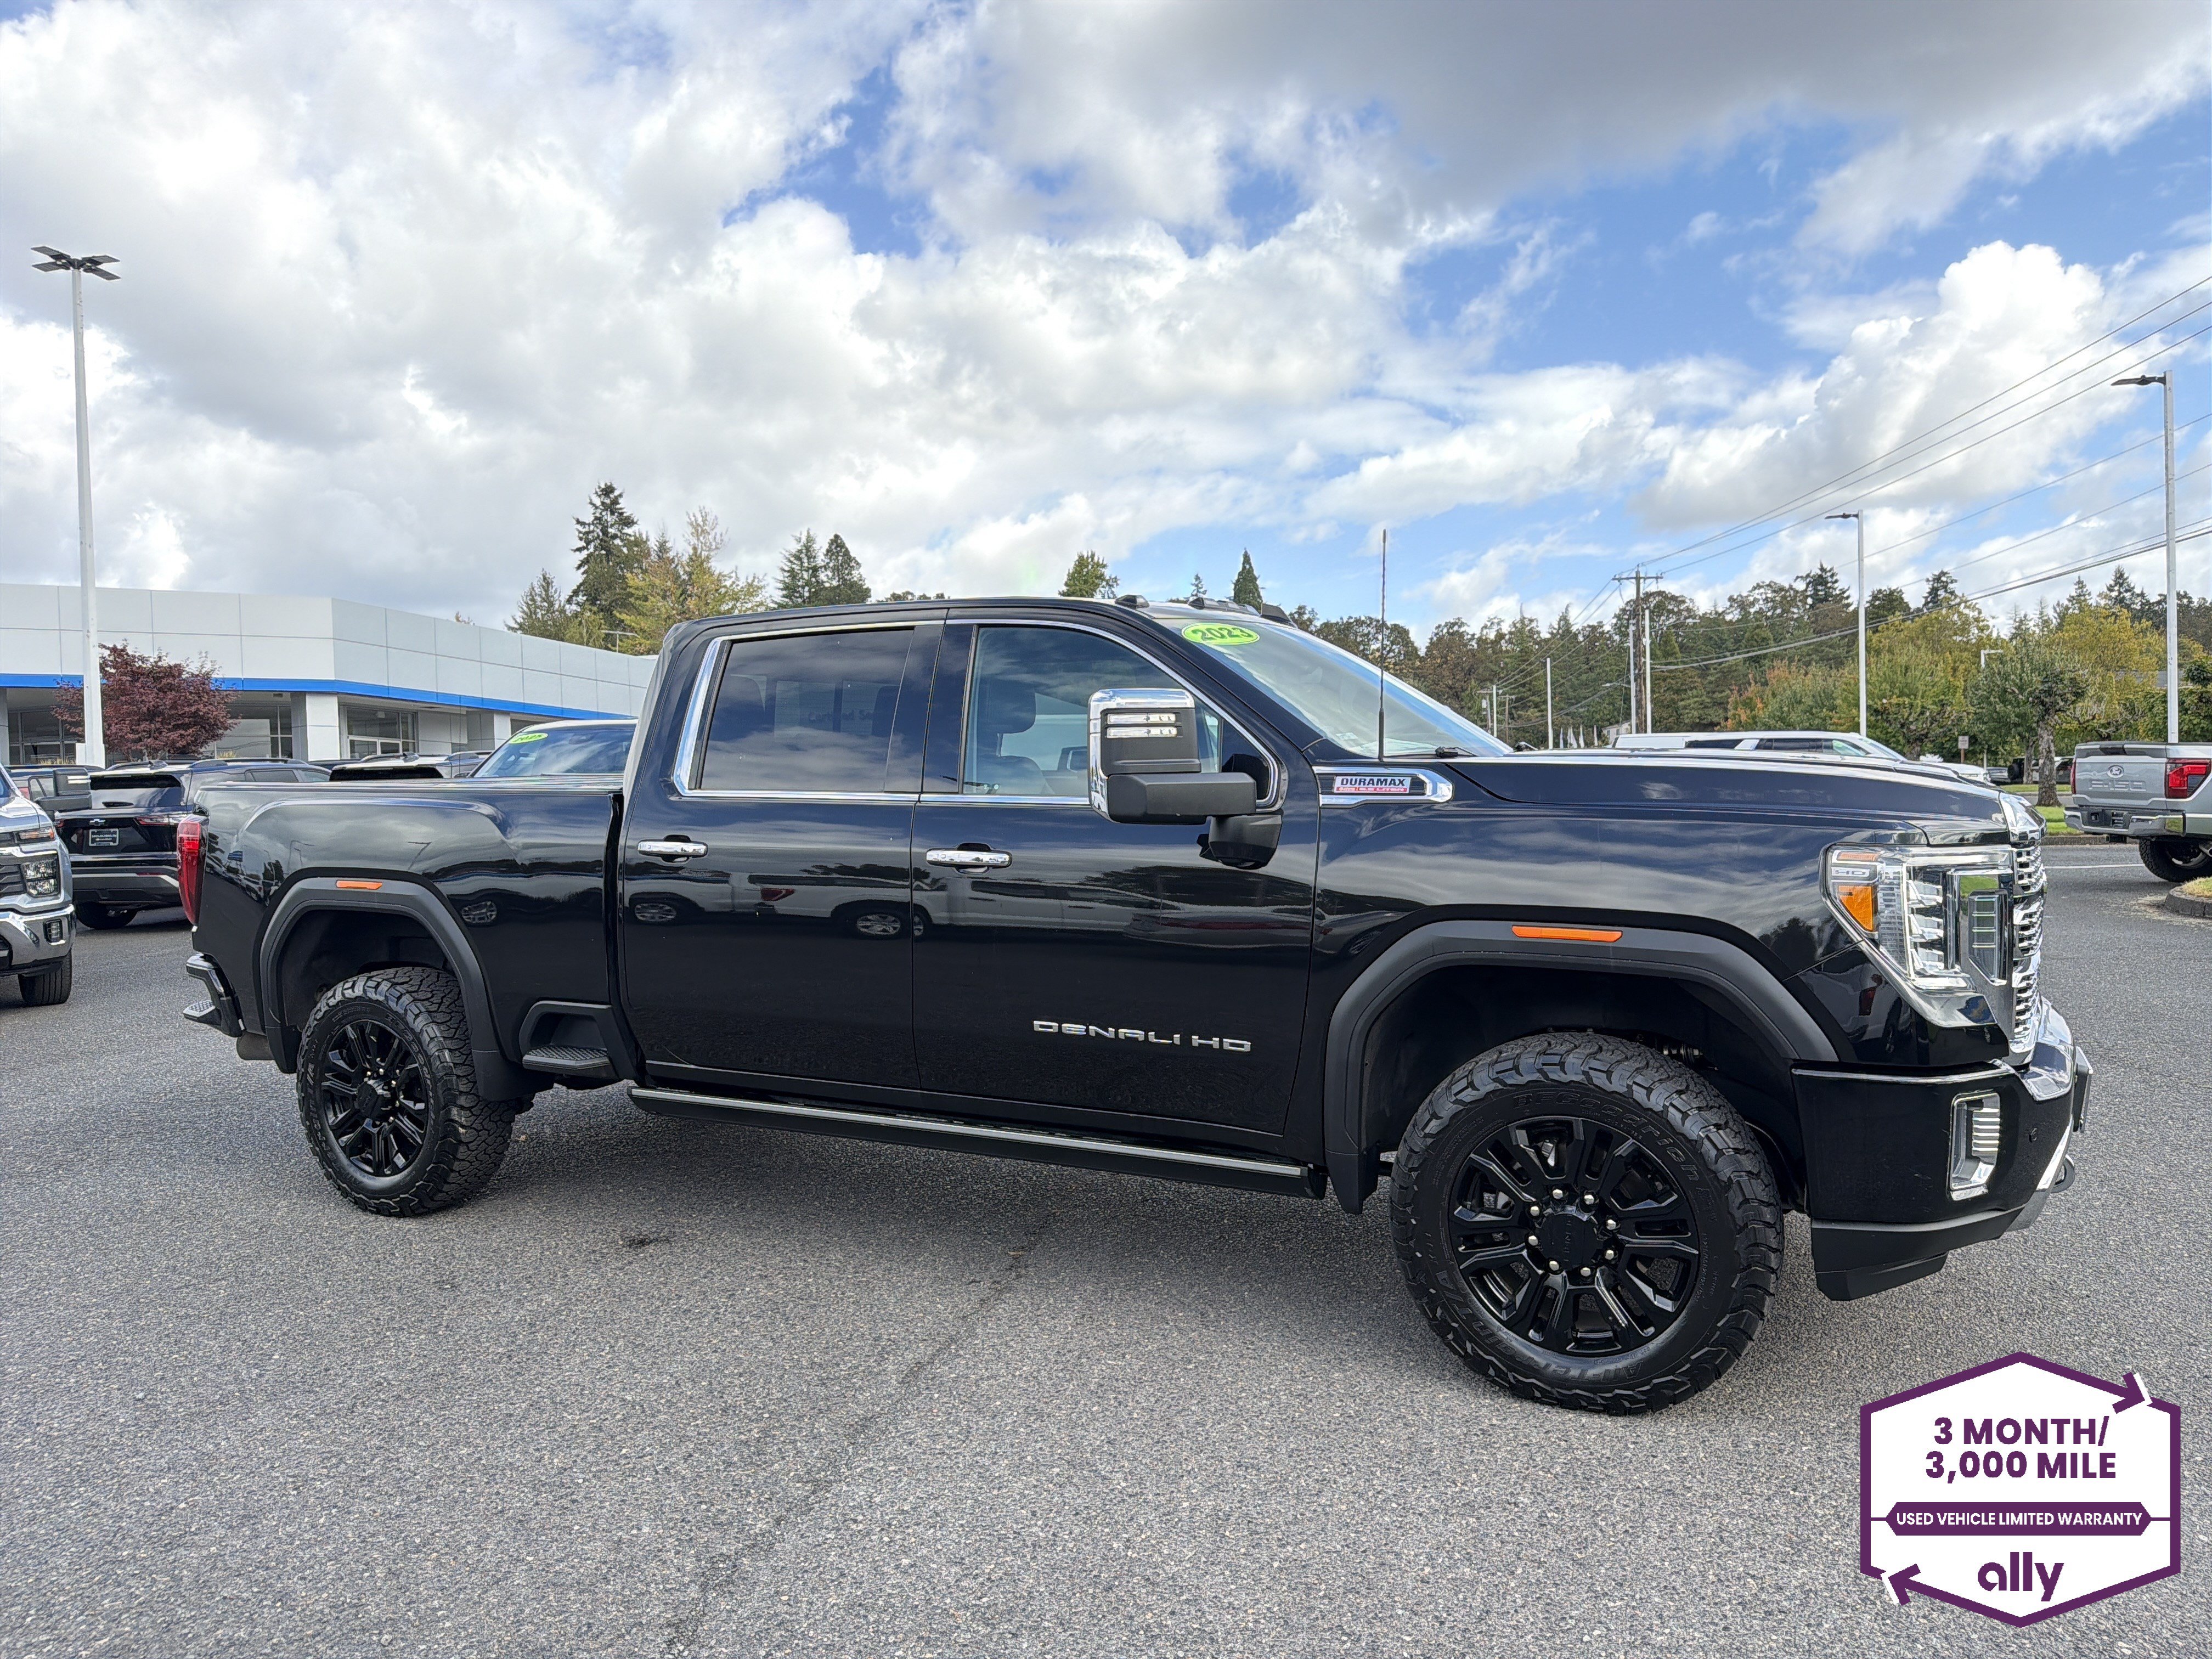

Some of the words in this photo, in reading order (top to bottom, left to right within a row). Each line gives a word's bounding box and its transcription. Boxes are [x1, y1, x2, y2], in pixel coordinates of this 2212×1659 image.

[1190, 627, 1254, 641] 2023
[1340, 778, 1406, 786] DURAMAX
[1033, 1020, 1181, 1045] DENALI
[1192, 1035, 1251, 1052] HD
